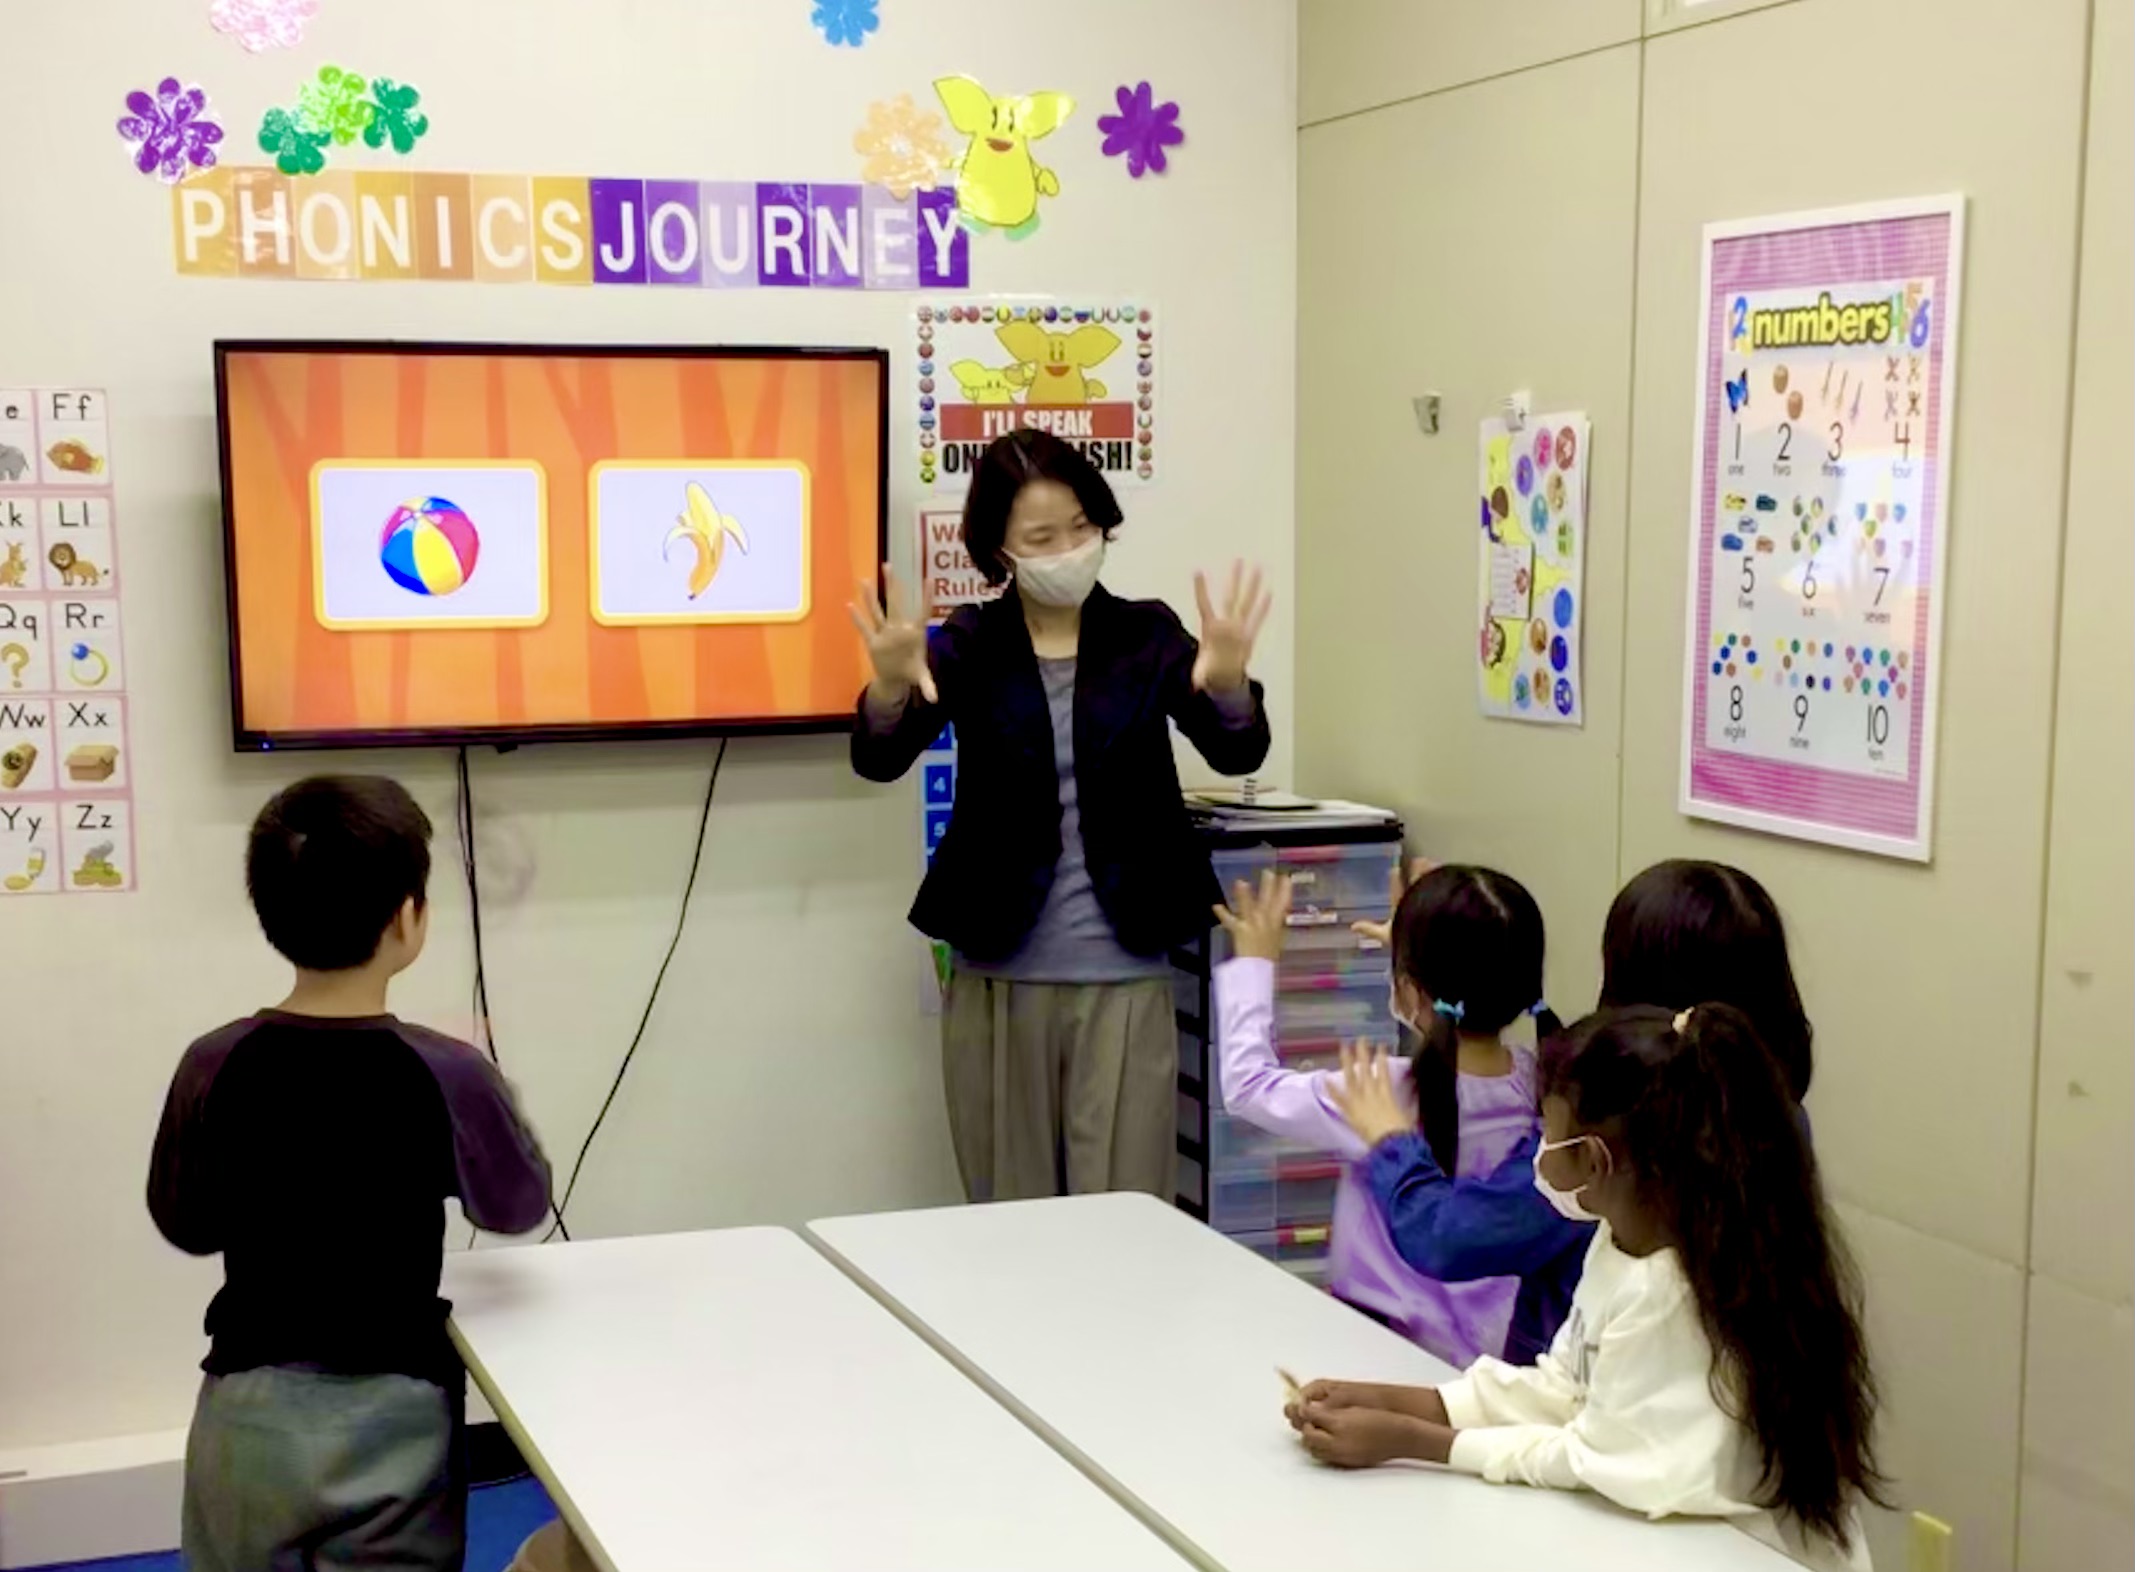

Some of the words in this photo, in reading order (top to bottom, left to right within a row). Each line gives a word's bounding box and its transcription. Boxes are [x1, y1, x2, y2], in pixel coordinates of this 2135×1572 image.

[182, 187, 584, 274] PHONICS
[600, 196, 961, 279] JOURNEY
[1753, 292, 1891, 348] numbers
[1022, 410, 1093, 437] SPEAK
[1777, 422, 1791, 461] 2
[1828, 422, 1843, 461] 3
[1894, 422, 1910, 461] 4
[1740, 556, 1755, 593] 5
[1802, 560, 1816, 599] 6
[1873, 567, 1890, 606] 7
[1730, 685, 1743, 721] 8
[1794, 695, 1808, 732] 9
[1867, 704, 1889, 744] 10
